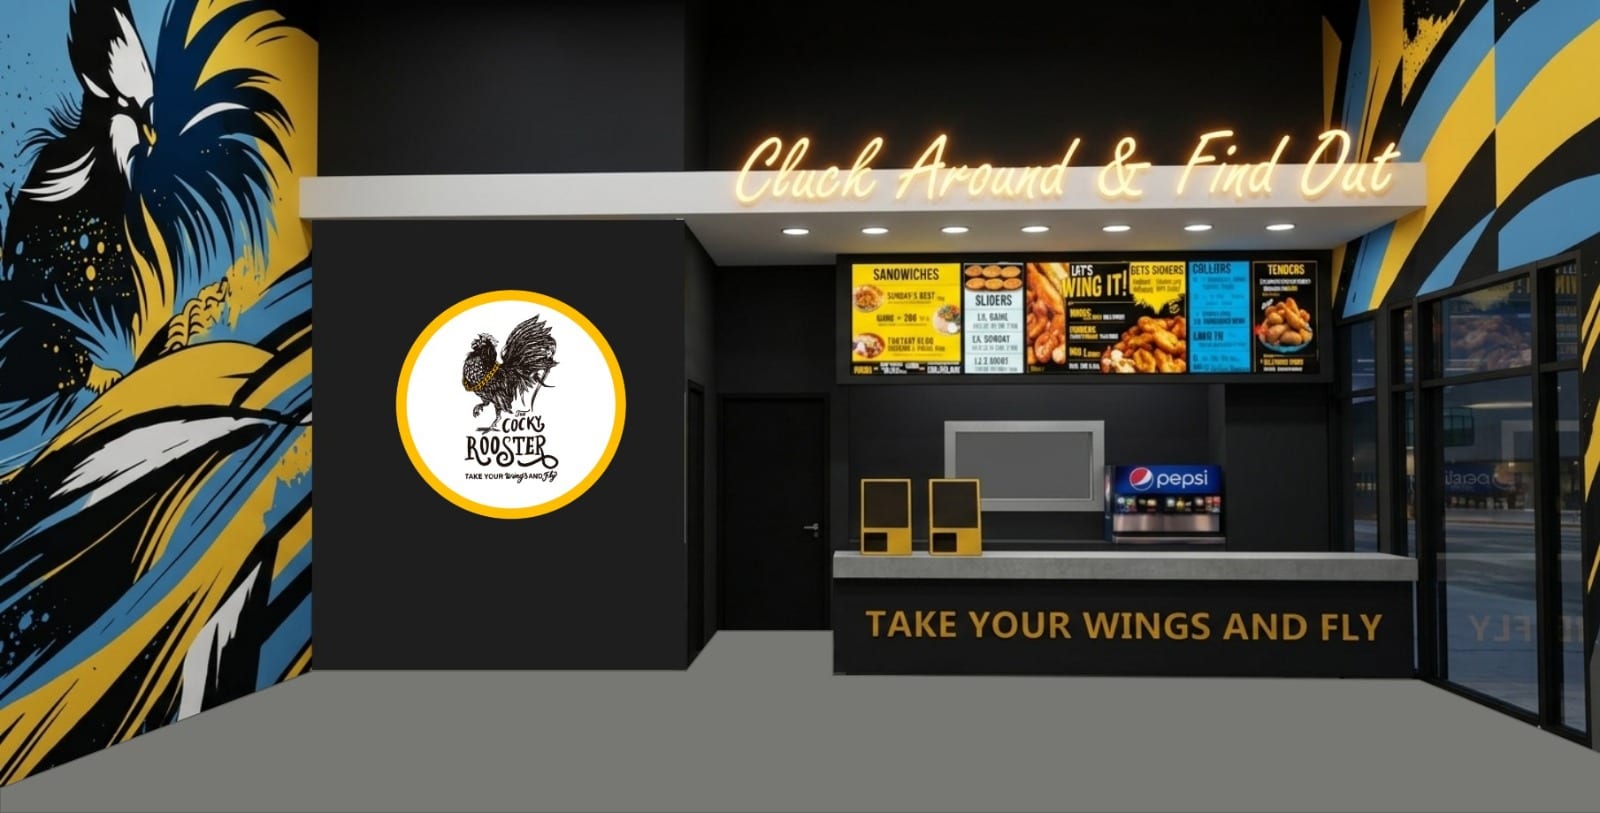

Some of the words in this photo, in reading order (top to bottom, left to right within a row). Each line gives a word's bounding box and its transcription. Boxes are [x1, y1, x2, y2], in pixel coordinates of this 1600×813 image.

[735, 136, 883, 203] Cluck
[895, 134, 1081, 200] Around
[1098, 136, 1152, 197] &
[1177, 129, 1290, 197] Find
[1300, 129, 1401, 197] Out
[873, 268, 940, 281] SANDWICHES
[1062, 275, 1102, 298] WING
[1106, 269, 1127, 296] IT!
[975, 295, 1012, 306] SLIDERS
[502, 415, 545, 433] COCKY
[464, 434, 559, 469] ROOSTER
[1156, 469, 1208, 489] pepsi
[865, 610, 957, 637] TAKE
[968, 611, 1072, 639] YOUR
[1082, 612, 1211, 640] WINGS
[1222, 613, 1308, 640] AND
[1321, 613, 1383, 641] FLY
